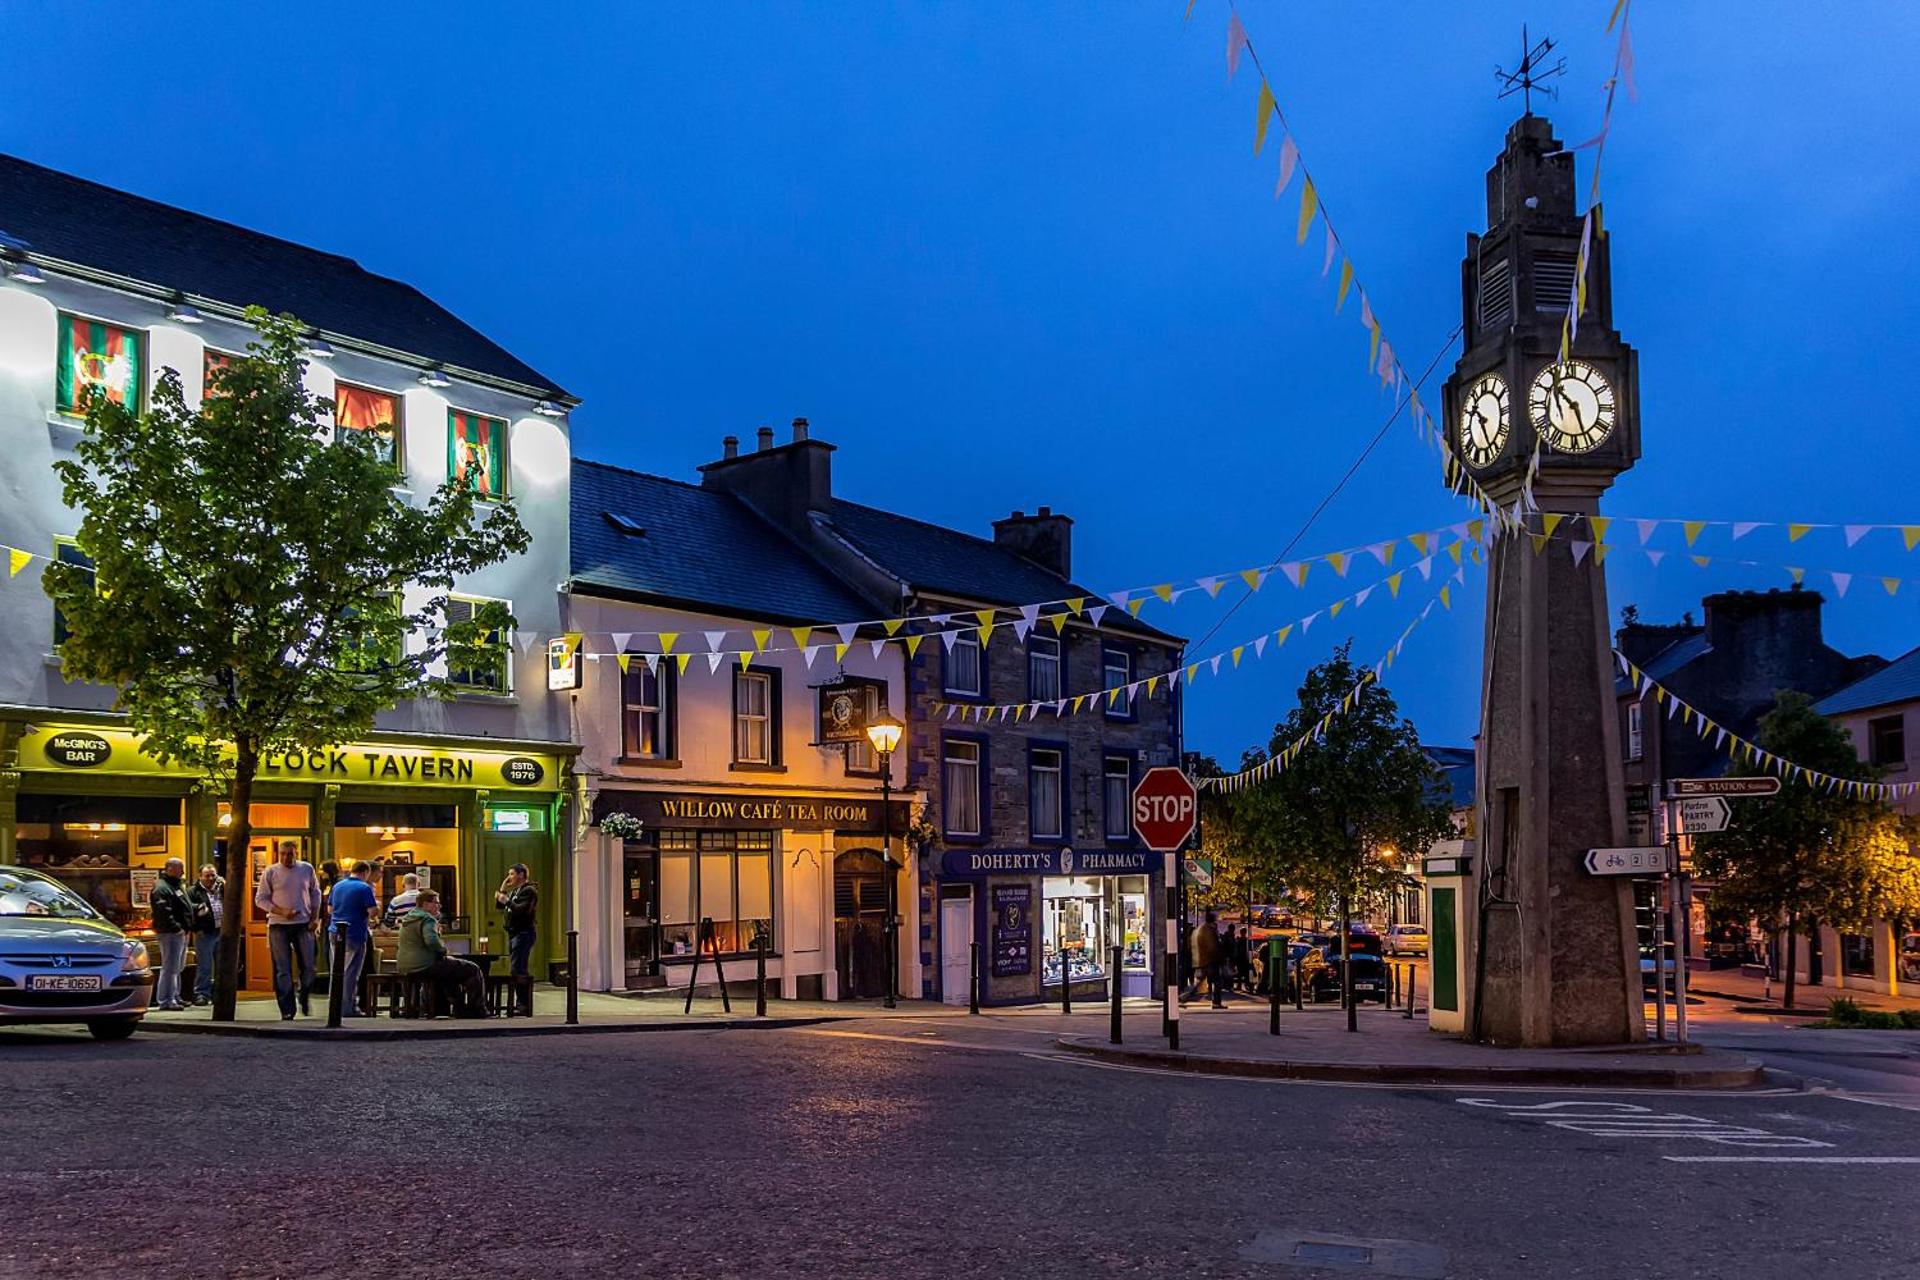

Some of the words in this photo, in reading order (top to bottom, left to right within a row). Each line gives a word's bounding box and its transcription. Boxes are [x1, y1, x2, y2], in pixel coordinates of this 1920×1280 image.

[54, 738, 107, 750] McGING'S
[65, 751, 96, 761] BAR
[363, 753, 473, 779] TAVERN
[510, 771, 536, 780] 1976
[662, 800, 737, 819] WILLOW
[740, 800, 783, 820] CAFÉ
[787, 804, 817, 820] TEA
[823, 805, 868, 821] ROOM
[1136, 795, 1193, 822] STOP
[971, 853, 1051, 870] DOHERTY'S
[1082, 853, 1146, 868] PHARMACY
[35, 978, 98, 989] 01-KE-10652
